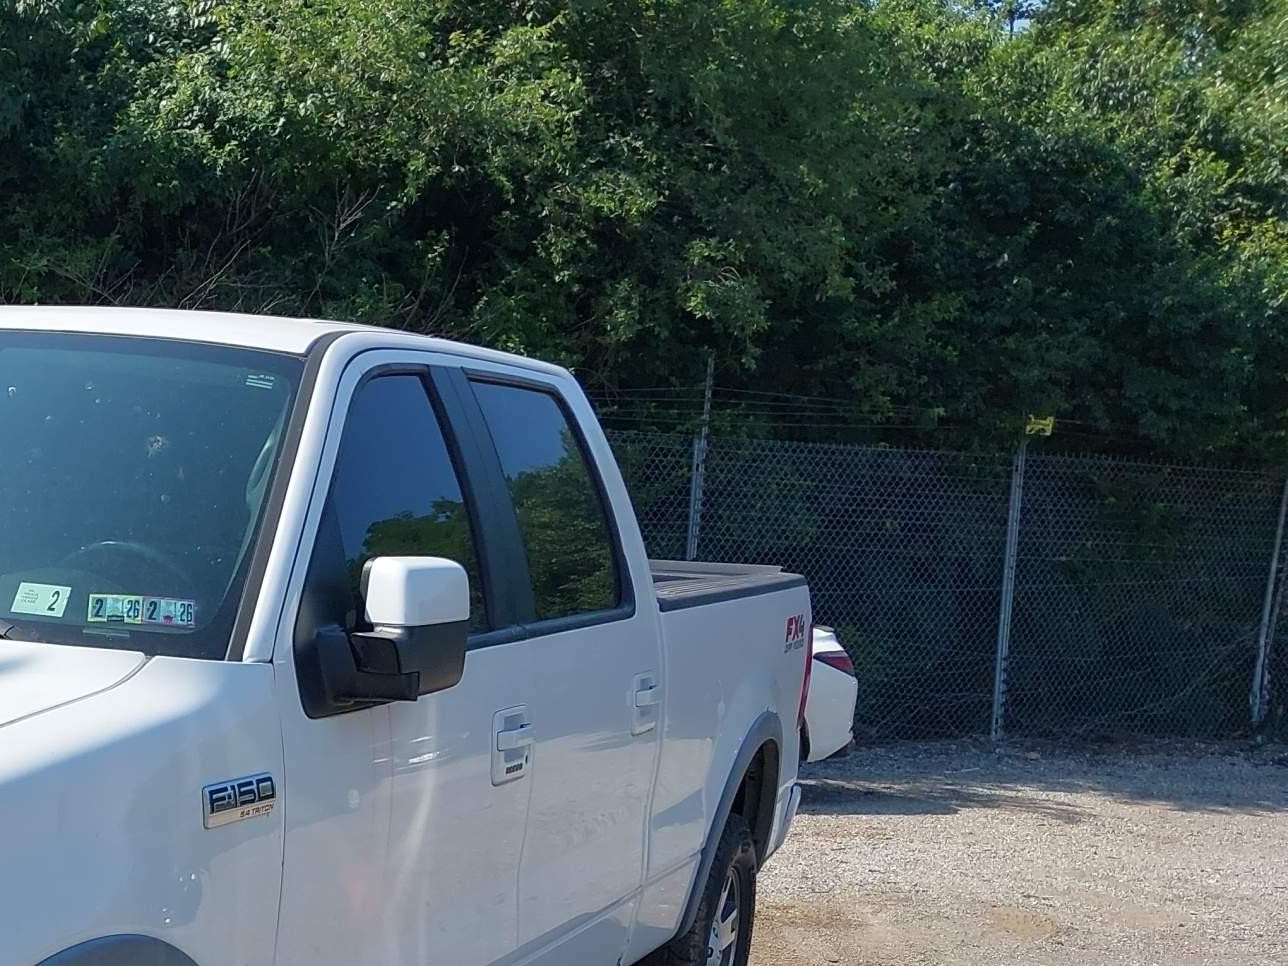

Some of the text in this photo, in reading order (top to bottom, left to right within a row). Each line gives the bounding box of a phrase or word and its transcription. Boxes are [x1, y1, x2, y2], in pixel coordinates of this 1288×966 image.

[47, 590, 60, 612] 2
[94, 598, 140, 619] 2 26
[146, 601, 193, 623] 2 26
